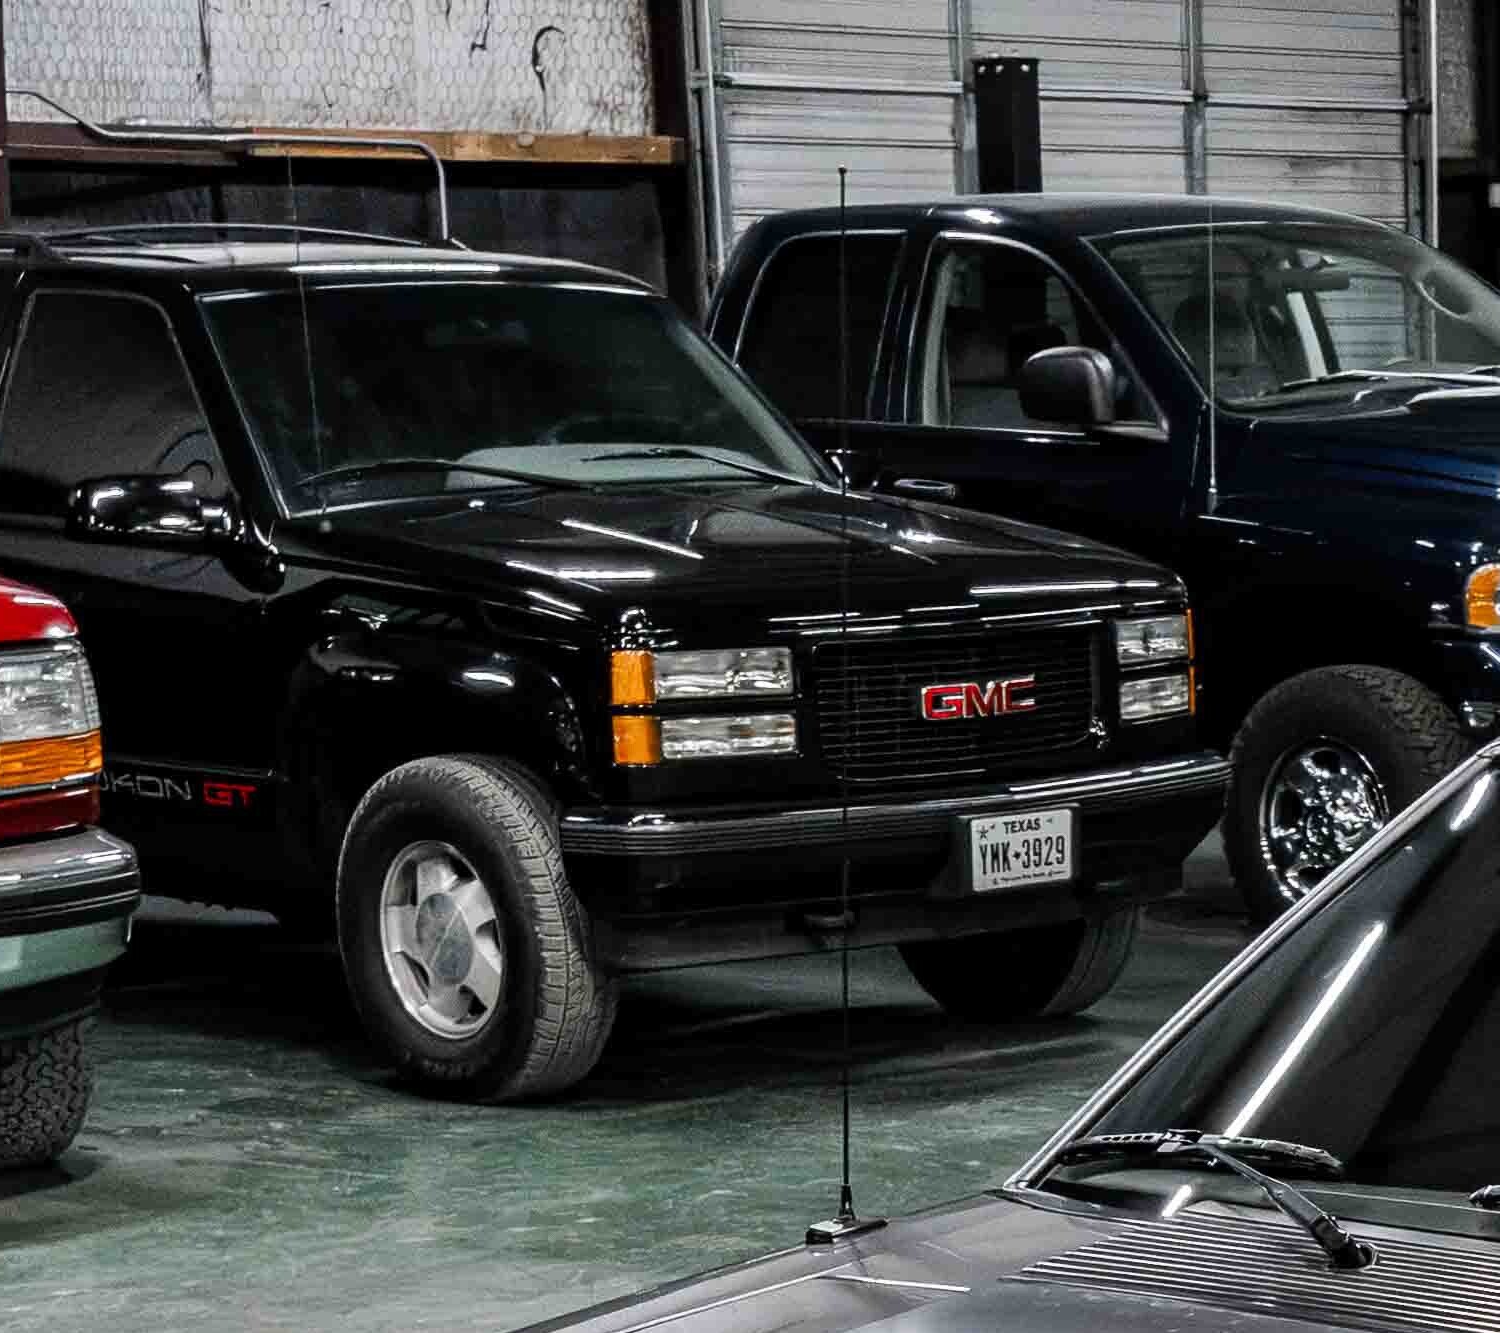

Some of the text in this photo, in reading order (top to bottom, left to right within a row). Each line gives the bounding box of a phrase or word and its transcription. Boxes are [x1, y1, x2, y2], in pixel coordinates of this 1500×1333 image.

[921, 674, 1036, 720] GMC
[203, 782, 257, 806] GT
[1002, 818, 1041, 834] TEXAS
[1021, 835, 1065, 869] 3929
